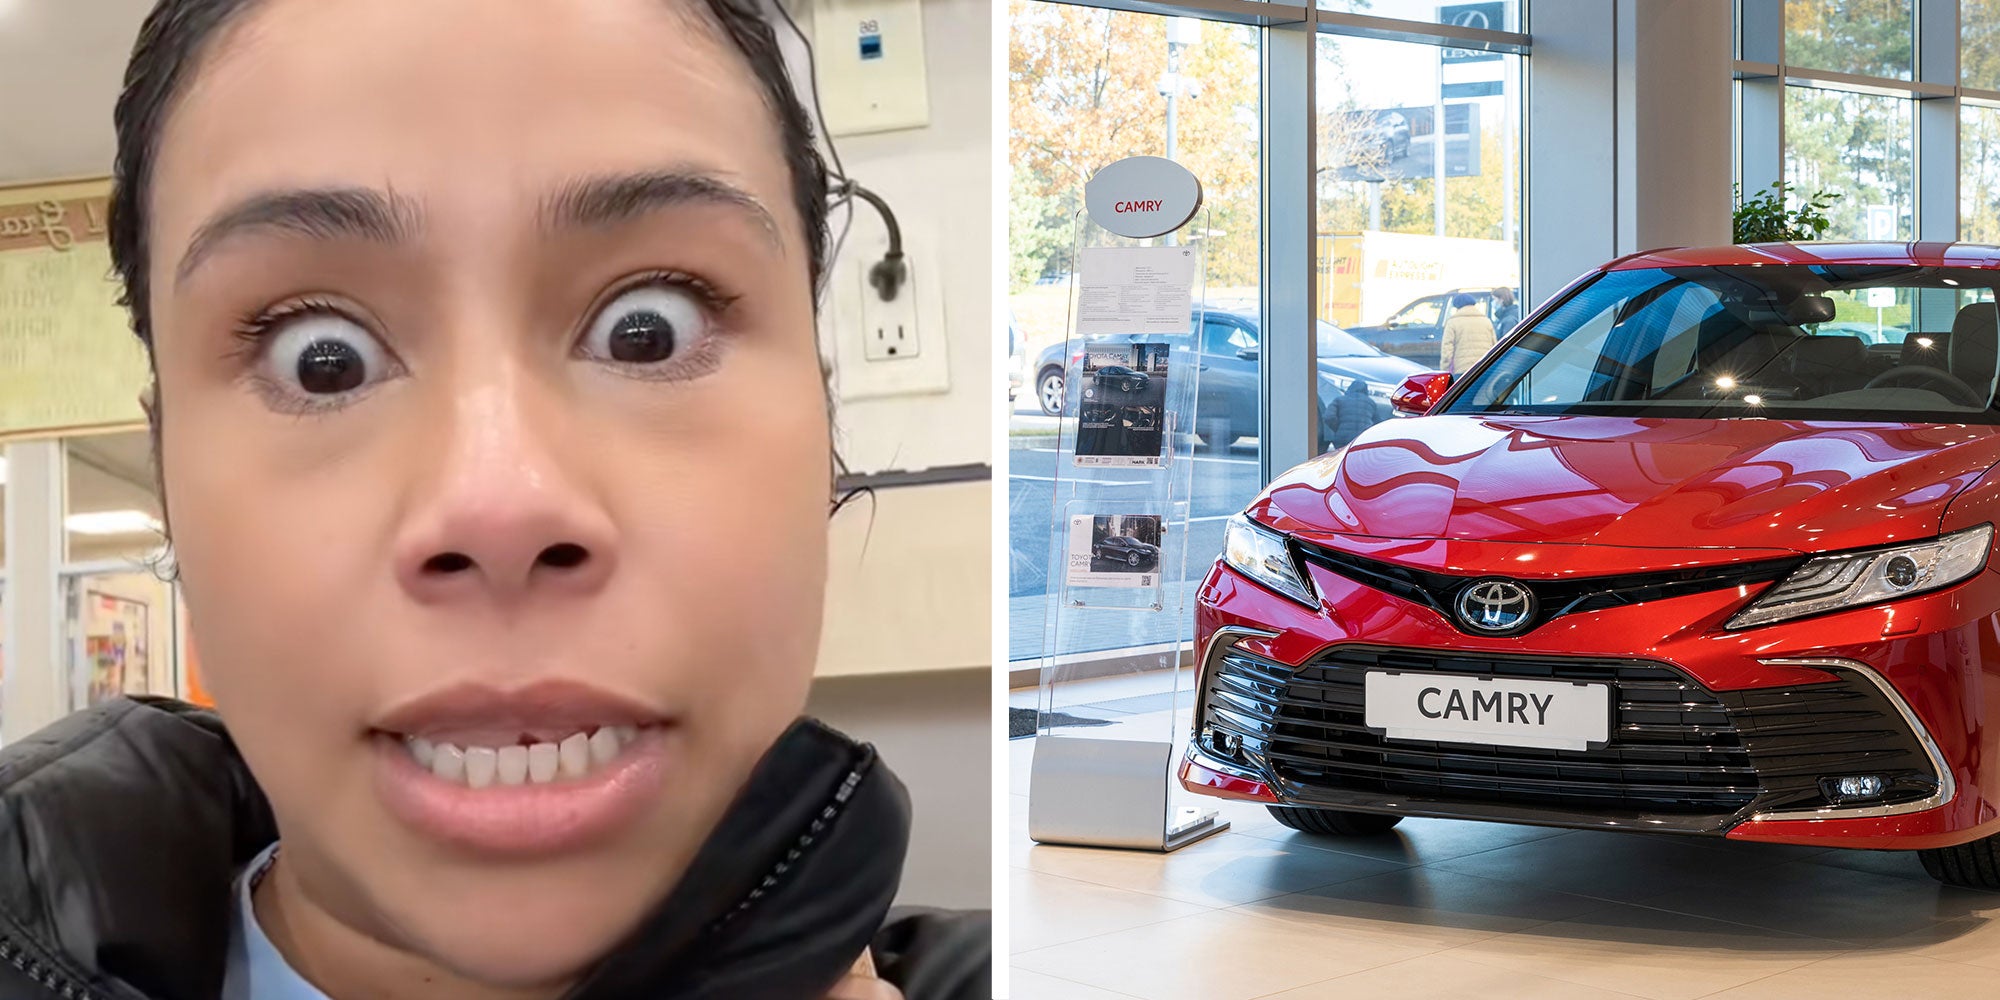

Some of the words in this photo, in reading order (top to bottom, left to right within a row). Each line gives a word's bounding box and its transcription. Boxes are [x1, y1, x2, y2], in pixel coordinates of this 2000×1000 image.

[1114, 199, 1163, 214] CAMRY
[1874, 210, 1892, 240] P
[1417, 686, 1554, 726] CAMRY
